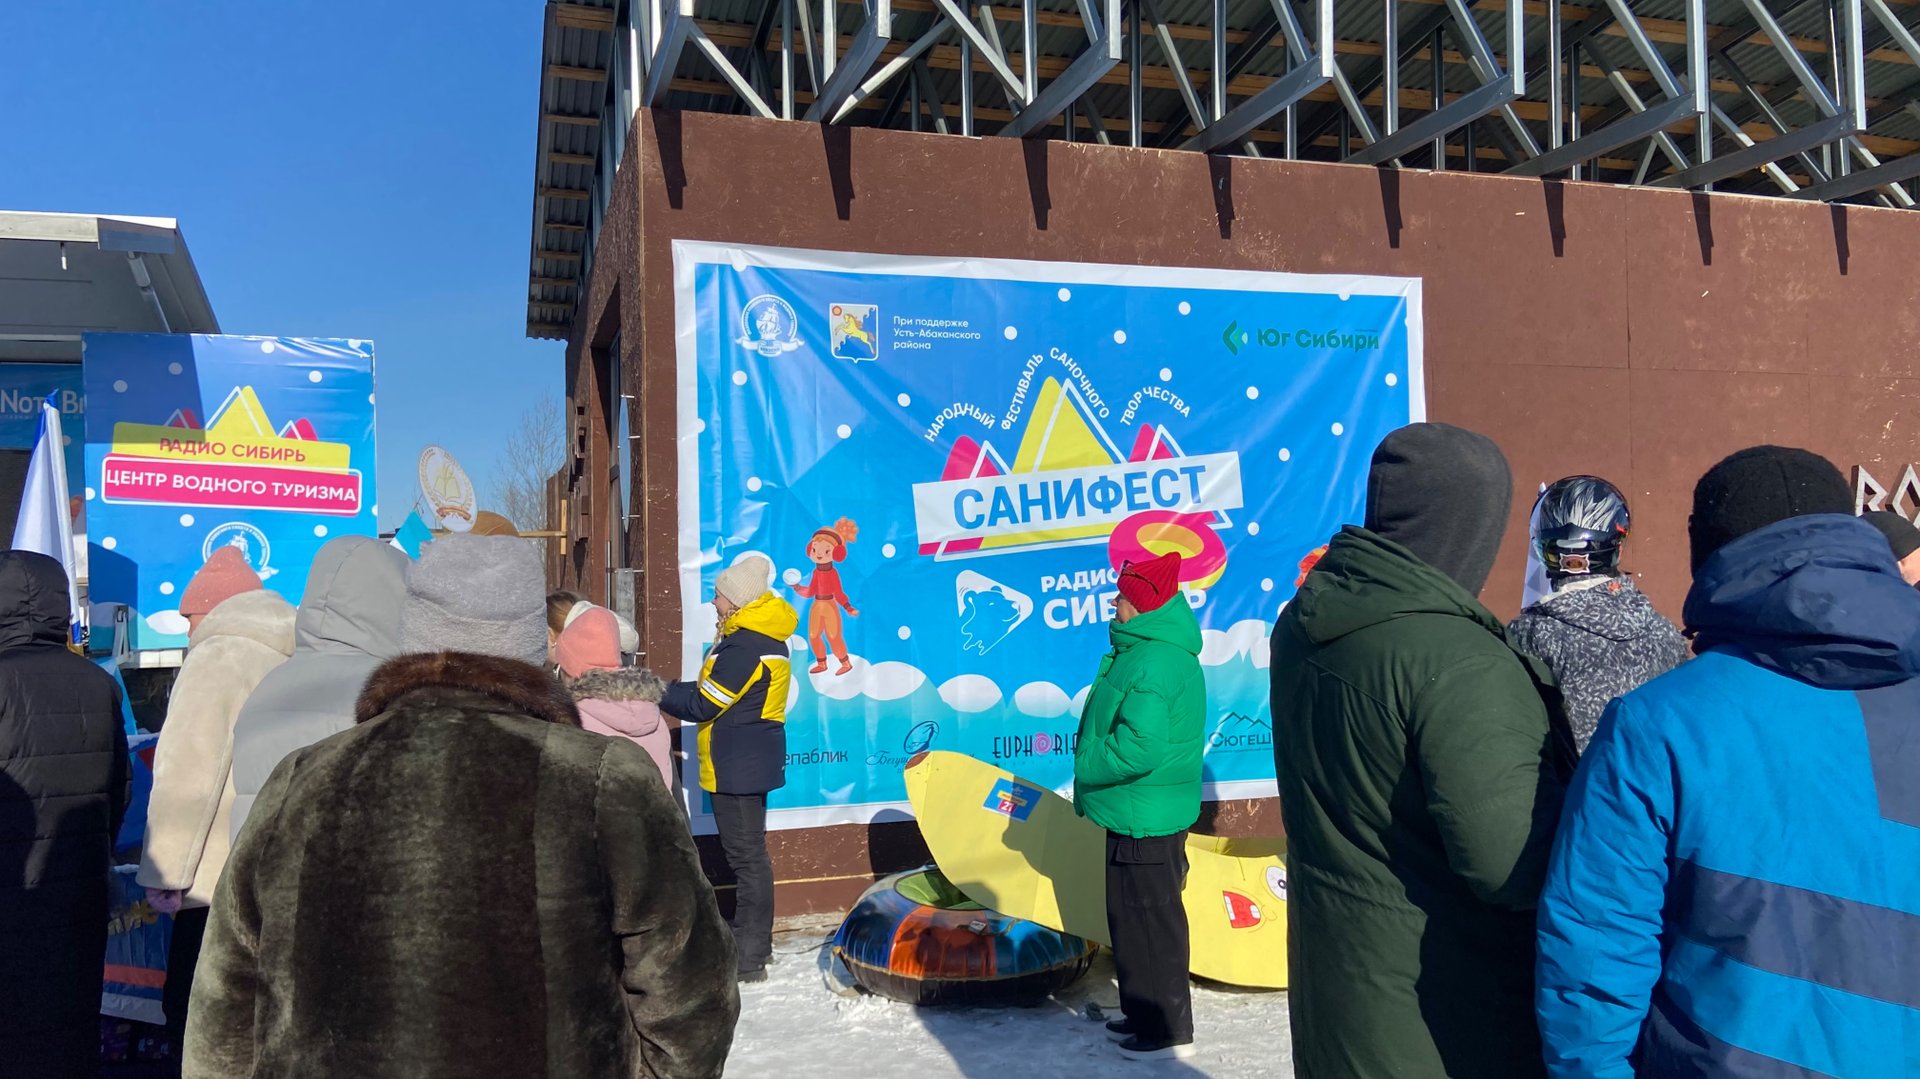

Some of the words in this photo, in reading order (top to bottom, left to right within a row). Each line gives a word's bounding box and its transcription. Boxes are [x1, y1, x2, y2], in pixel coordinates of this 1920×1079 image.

[893, 315, 913, 326] При
[915, 319, 969, 328] поддержке
[893, 327, 981, 340] Усть-Абаканского
[893, 340, 932, 350] района
[1257, 328, 1291, 347] Юг
[1295, 328, 1379, 352] Сибири
[924, 402, 996, 442] НАРОДНЫЙ
[1000, 352, 1044, 431] ФЕСТИВАЛЬ
[1050, 347, 1110, 419] САНОЧНОГО
[1120, 386, 1191, 427] ТВОРЧЕСТВА
[159, 438, 226, 456] РАДИО
[232, 443, 306, 462] СИБИРЬ
[106, 469, 167, 487] ЦЕНТР
[173, 475, 266, 495] ВОДНОГО
[272, 482, 356, 502] ТУРИЗМА
[954, 465, 1206, 530] САНИФЕСТ
[1043, 582, 1207, 630] СИБЬ
[785, 748, 848, 766] епаблик
